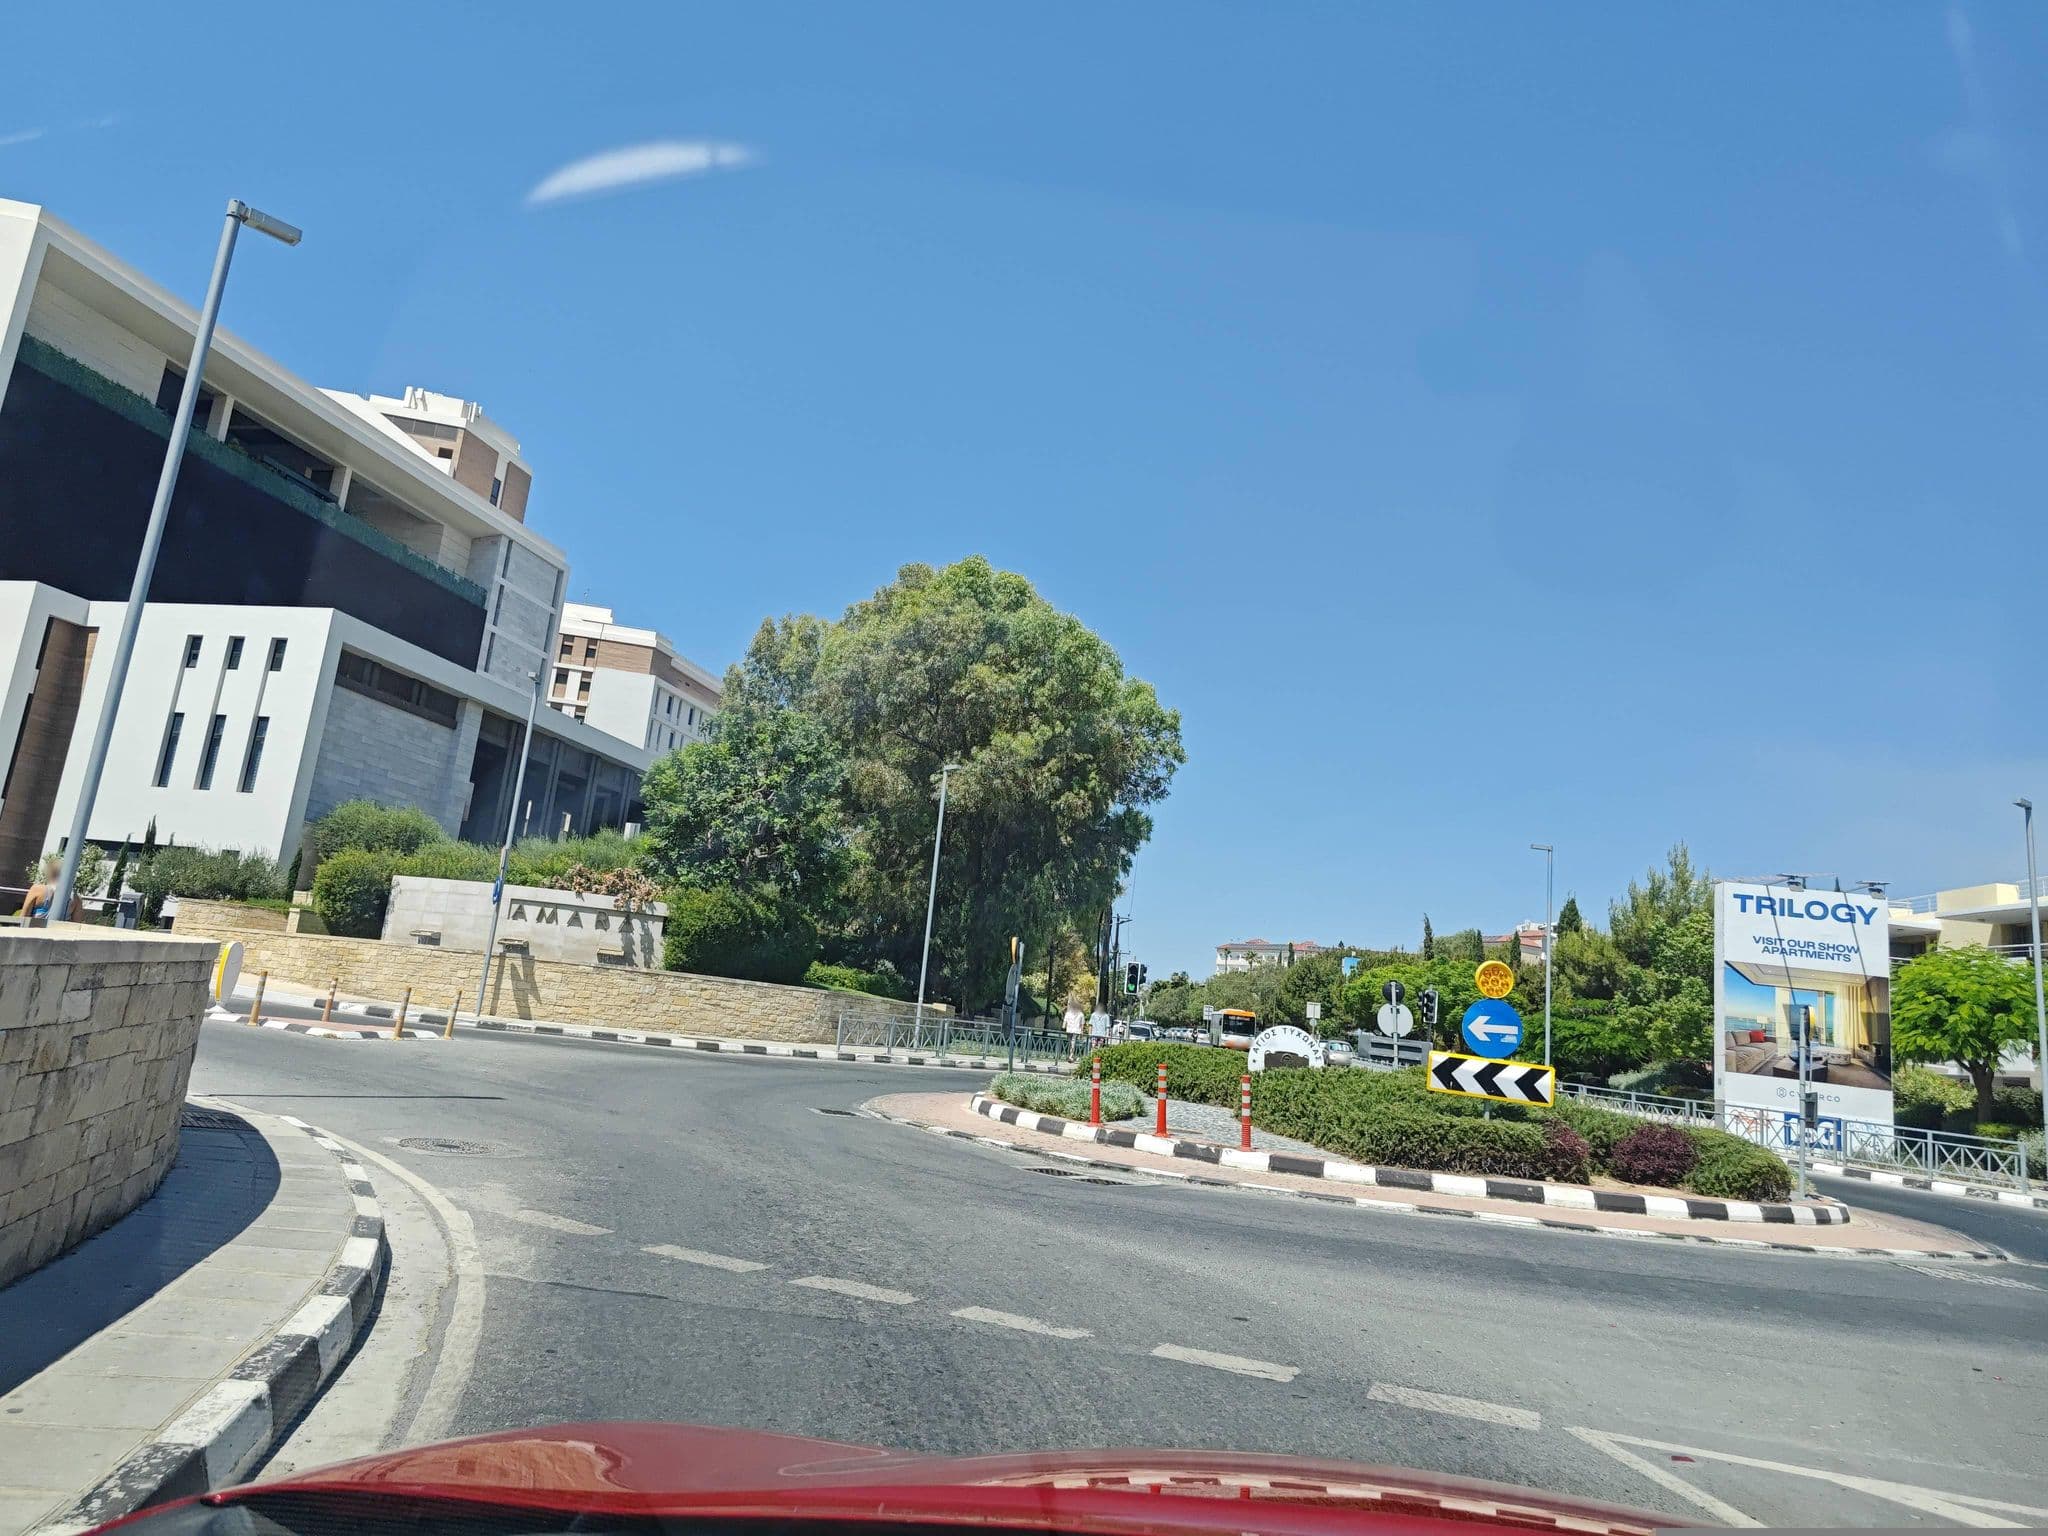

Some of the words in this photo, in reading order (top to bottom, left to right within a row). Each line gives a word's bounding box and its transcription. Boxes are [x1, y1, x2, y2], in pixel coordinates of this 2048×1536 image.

[511, 903, 635, 934] AMARA
[1733, 893, 1878, 925] TRILOGY
[1752, 935, 1785, 949] VISIT
[1787, 939, 1815, 951] OUR
[1818, 942, 1860, 954] SHOW
[1761, 945, 1851, 962] APARTMENTS
[1252, 1029, 1277, 1054] ΑΓΙΟΣ
